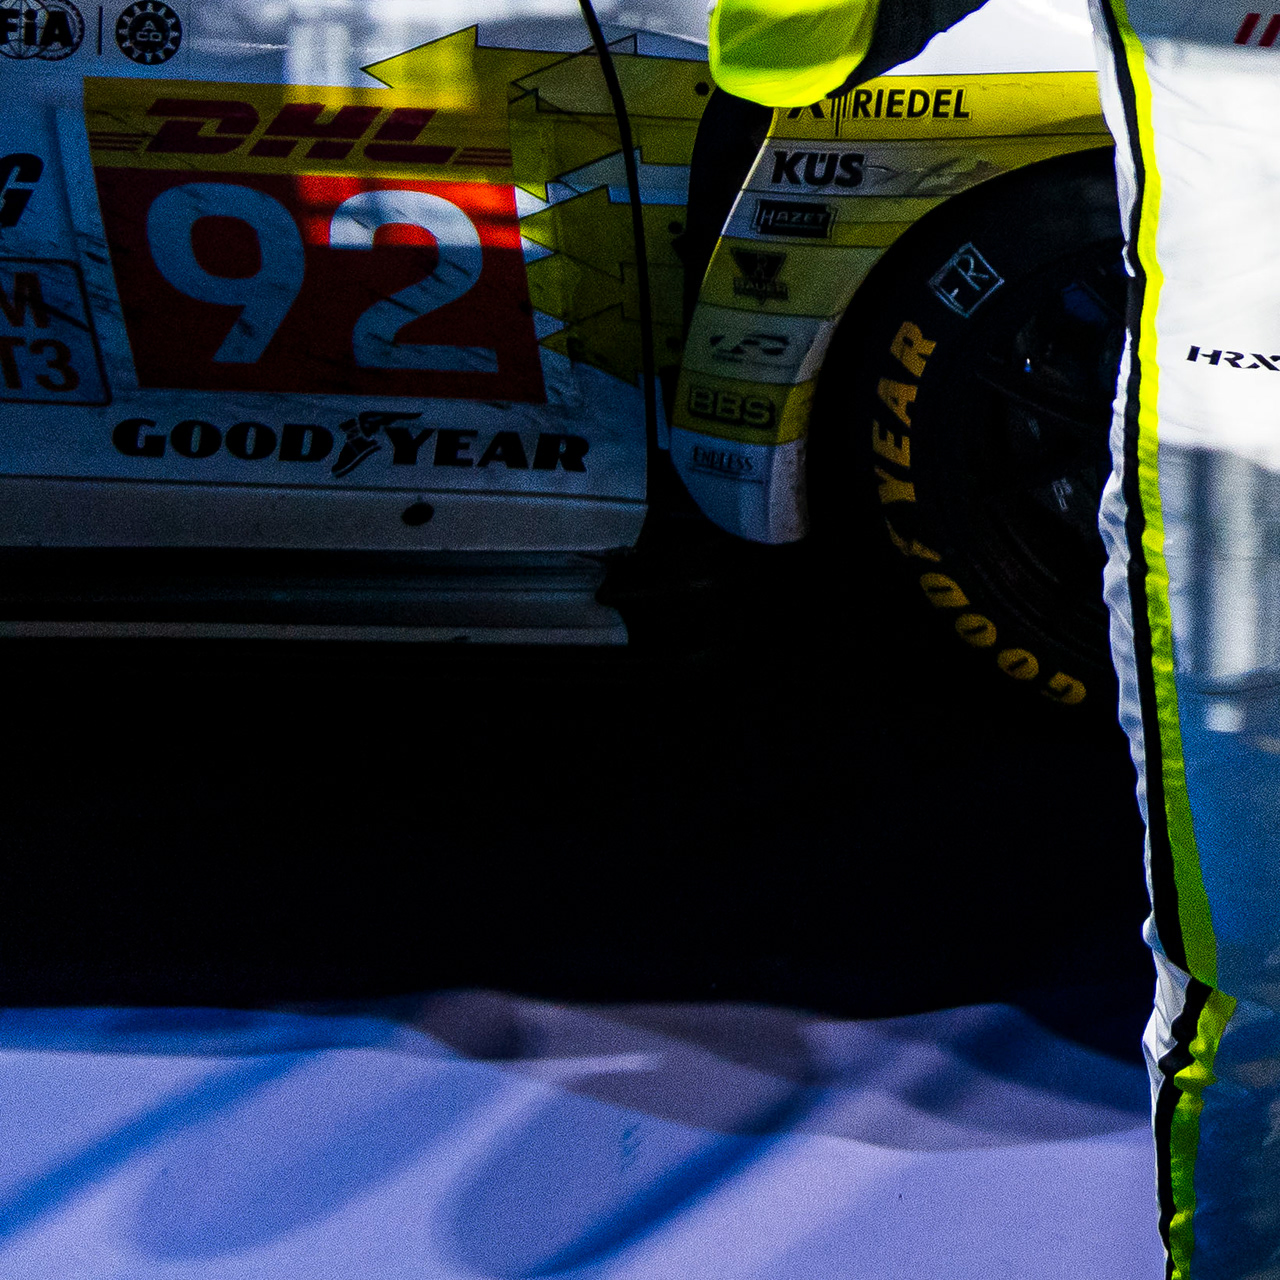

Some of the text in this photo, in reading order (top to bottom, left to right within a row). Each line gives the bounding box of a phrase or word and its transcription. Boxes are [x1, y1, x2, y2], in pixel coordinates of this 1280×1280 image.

[852, 88, 970, 120] RIEDEL
[145, 98, 457, 165] DHL
[771, 150, 865, 188] KÜS
[760, 208, 827, 226] HAZET
[146, 181, 499, 373] 92
[690, 386, 772, 424] BBS
